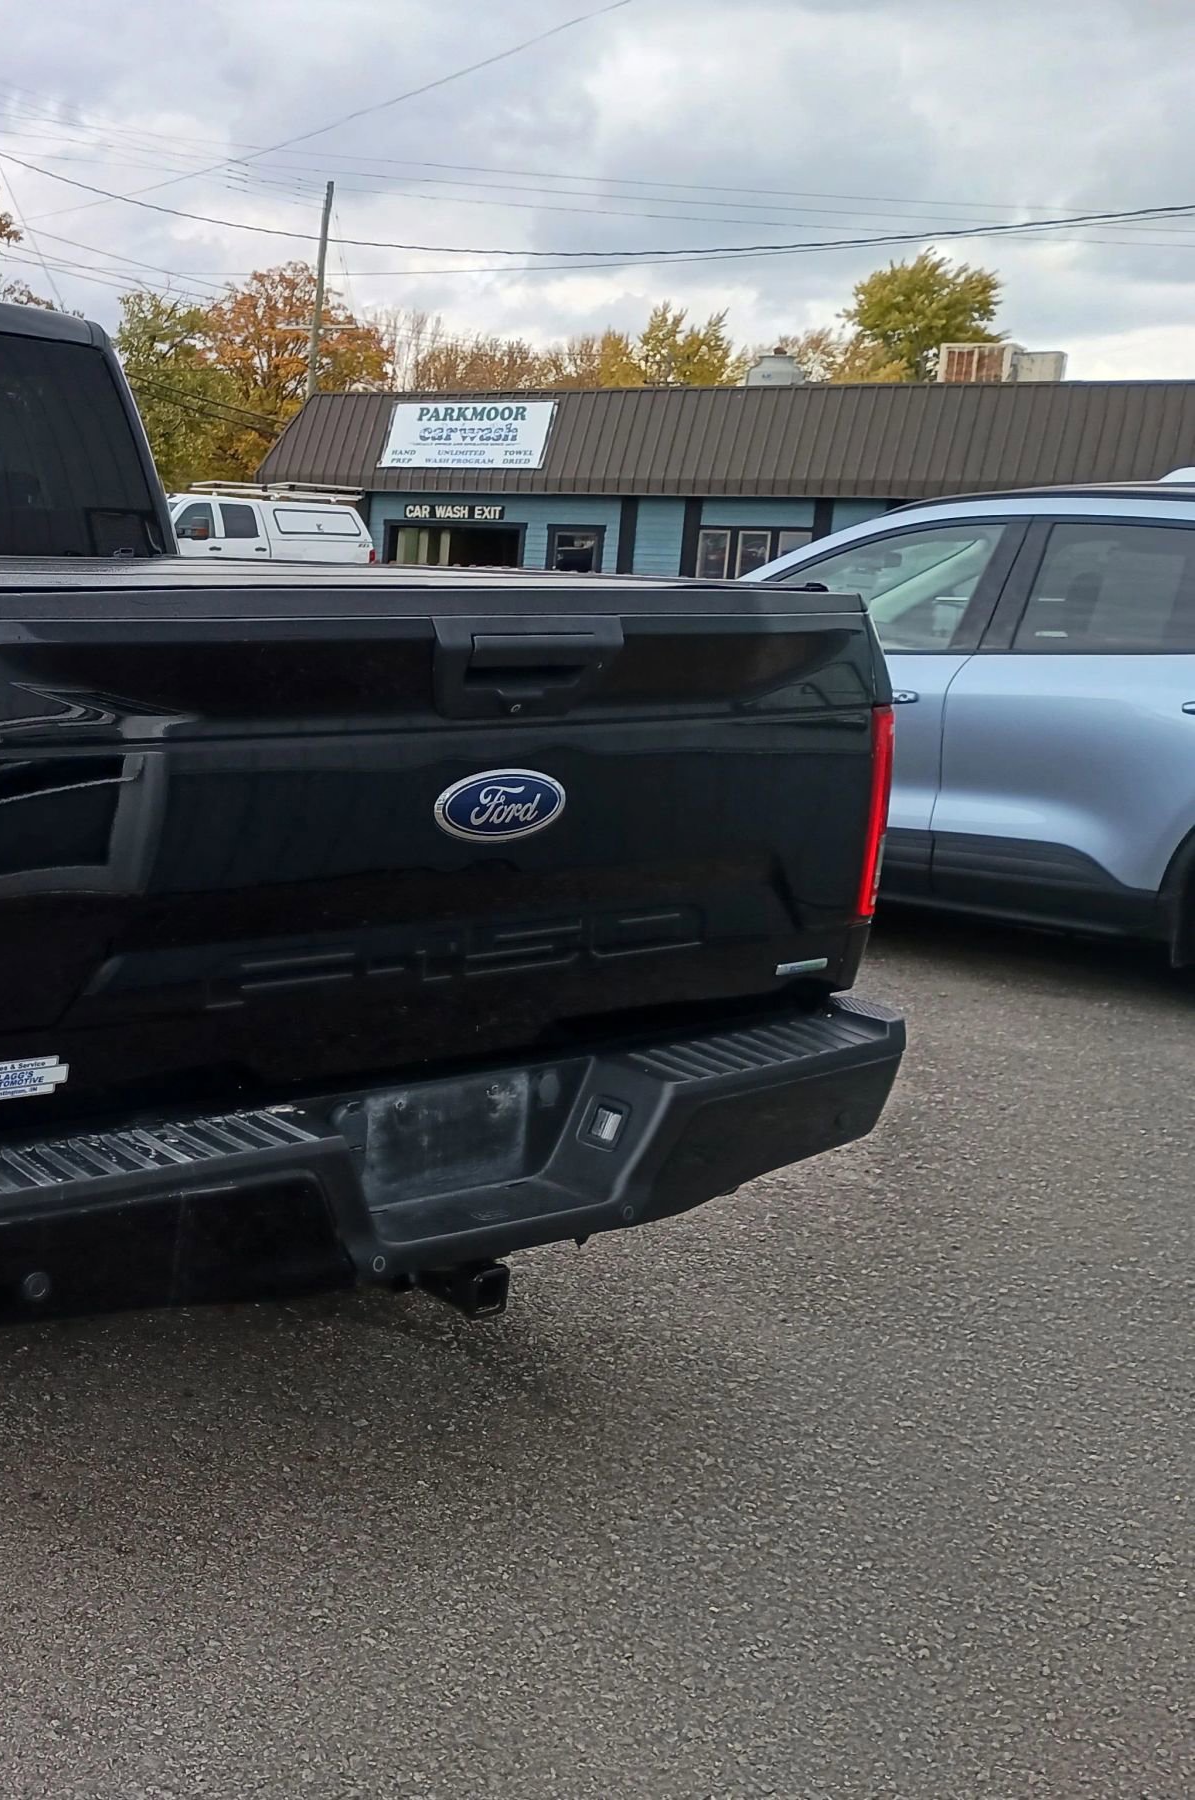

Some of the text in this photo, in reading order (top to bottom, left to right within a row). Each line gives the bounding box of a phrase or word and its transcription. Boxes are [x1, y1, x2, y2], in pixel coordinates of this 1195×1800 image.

[417, 406, 527, 421] PARKMOOR
[405, 505, 502, 519] CAR WASH EXIT
[469, 785, 542, 826] Ford
